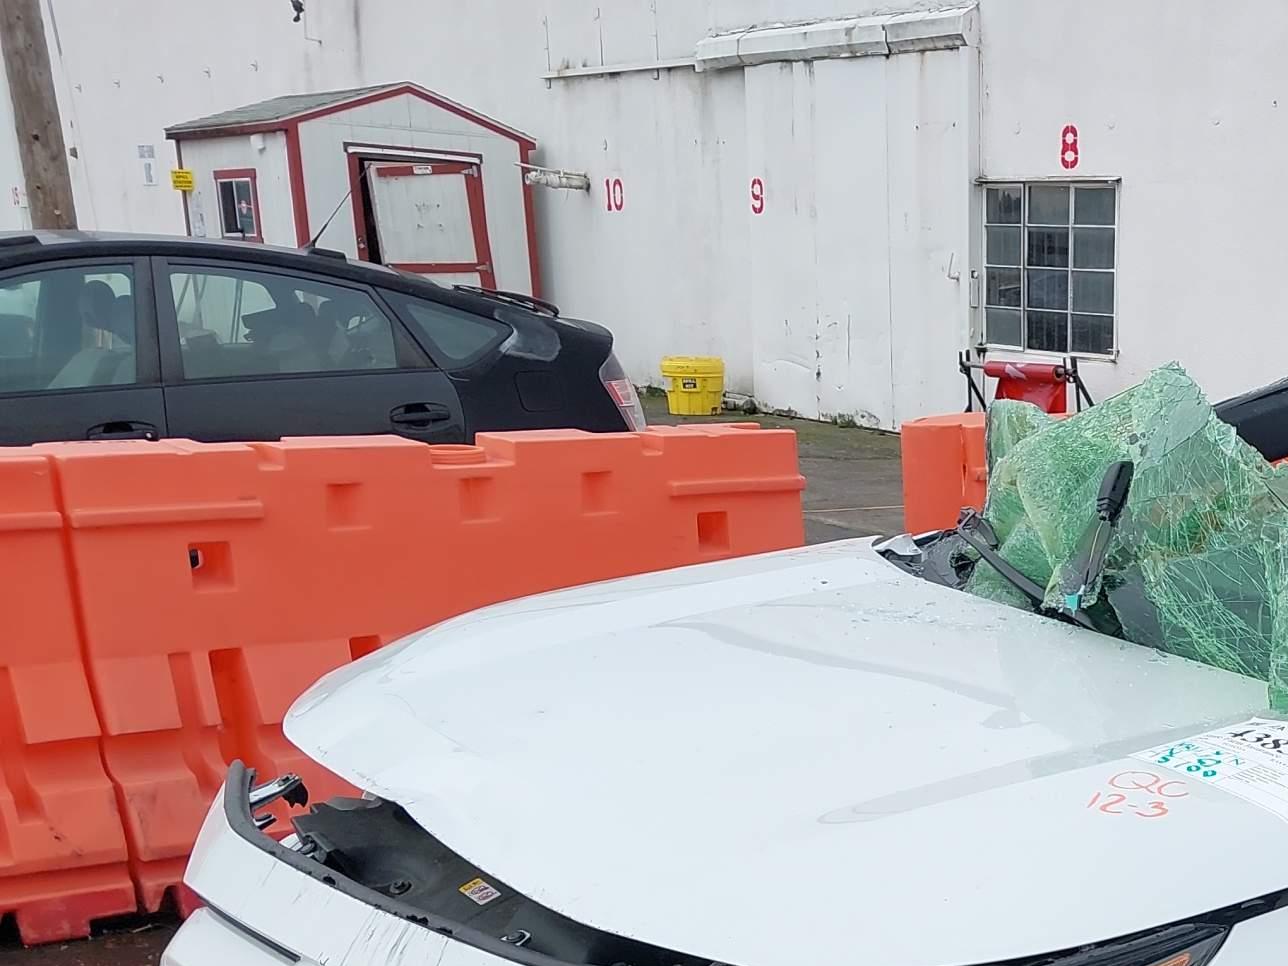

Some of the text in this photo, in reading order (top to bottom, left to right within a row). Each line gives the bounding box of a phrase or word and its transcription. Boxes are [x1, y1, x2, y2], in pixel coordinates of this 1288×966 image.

[1061, 125, 1079, 170] 8
[605, 178, 624, 211] 10
[751, 178, 764, 214] 9
[1108, 771, 1190, 798] QC
[1087, 792, 1169, 818] 12-3
